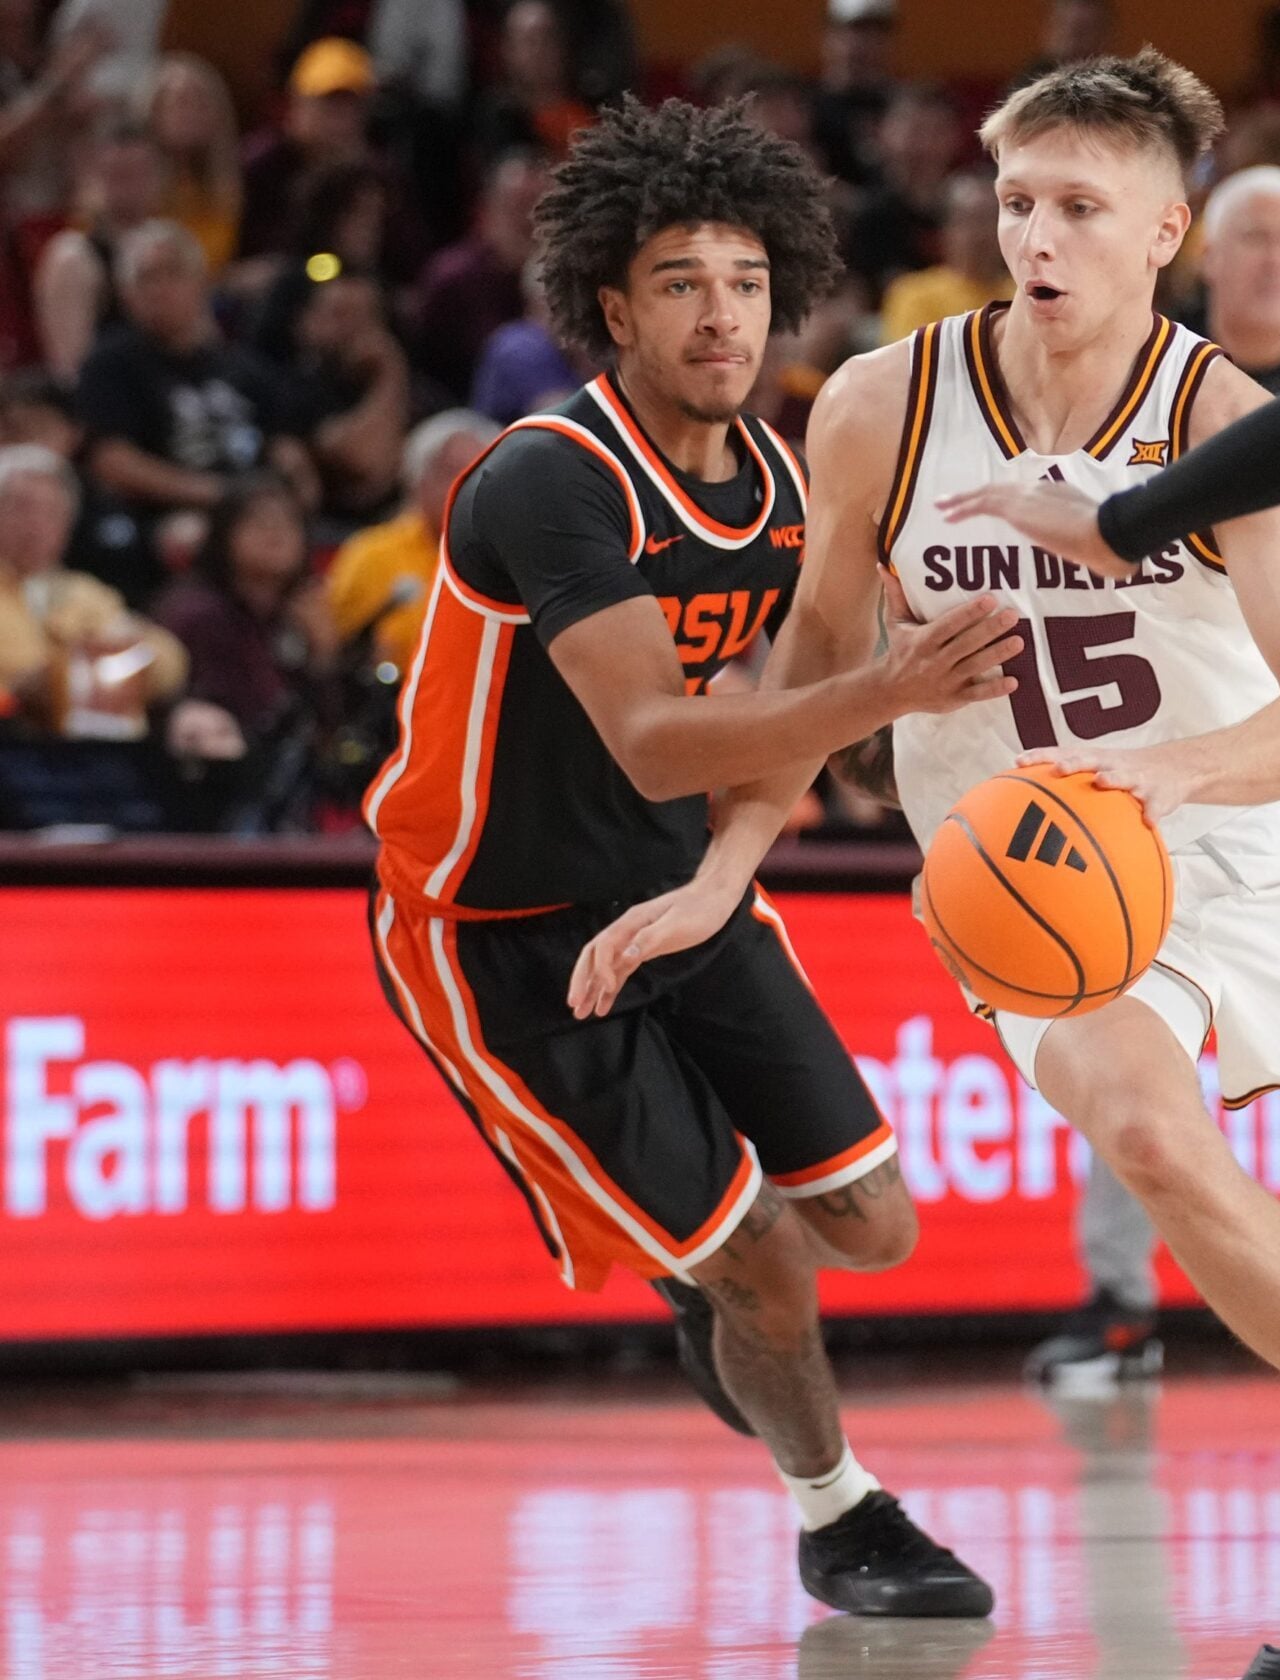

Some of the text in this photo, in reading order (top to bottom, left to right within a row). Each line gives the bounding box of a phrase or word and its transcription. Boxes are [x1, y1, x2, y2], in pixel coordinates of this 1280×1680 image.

[768, 525, 805, 549] WCC
[922, 541, 1185, 592] SUN DELS
[990, 611, 1162, 751] 15
